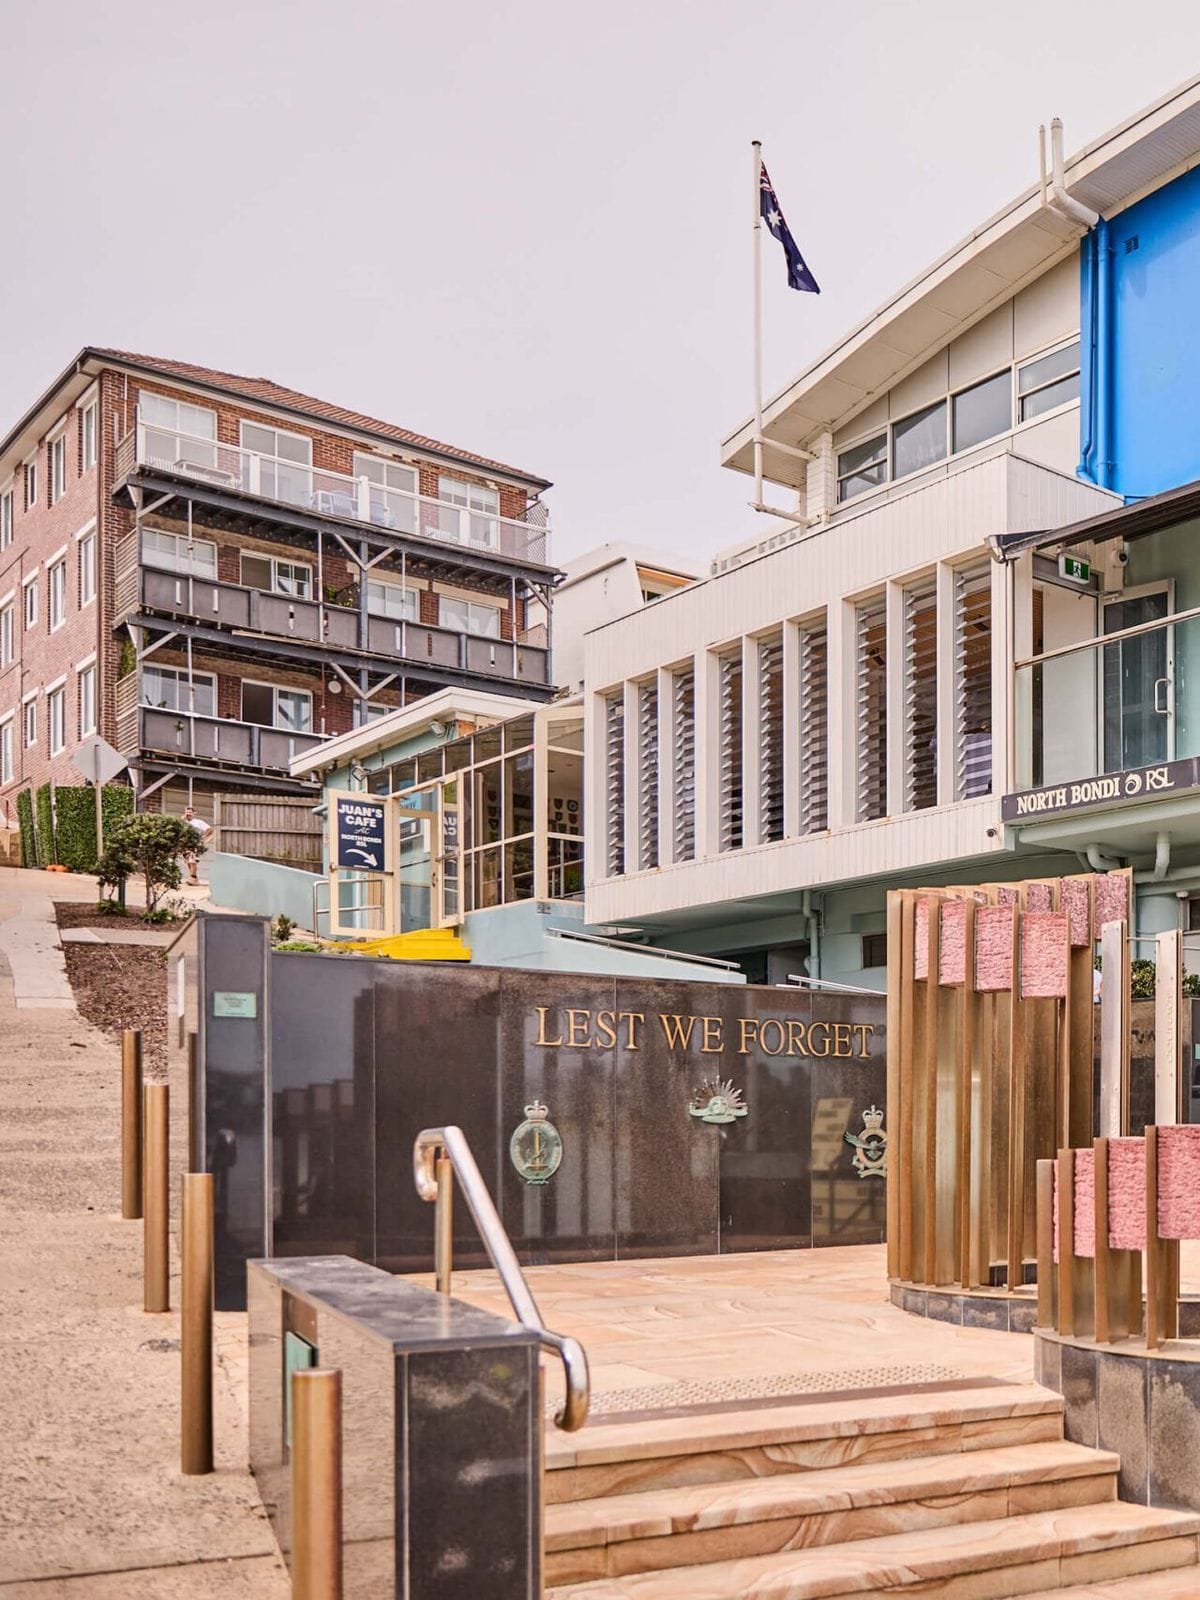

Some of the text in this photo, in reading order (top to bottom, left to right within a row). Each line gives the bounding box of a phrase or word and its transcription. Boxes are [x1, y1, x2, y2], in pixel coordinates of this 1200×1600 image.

[1017, 767, 1175, 814] NORTH BONDI RSL
[338, 804, 383, 818] JUAN'S
[345, 815, 377, 828] CAFE
[535, 1007, 874, 1058] LEST WE FORGET
